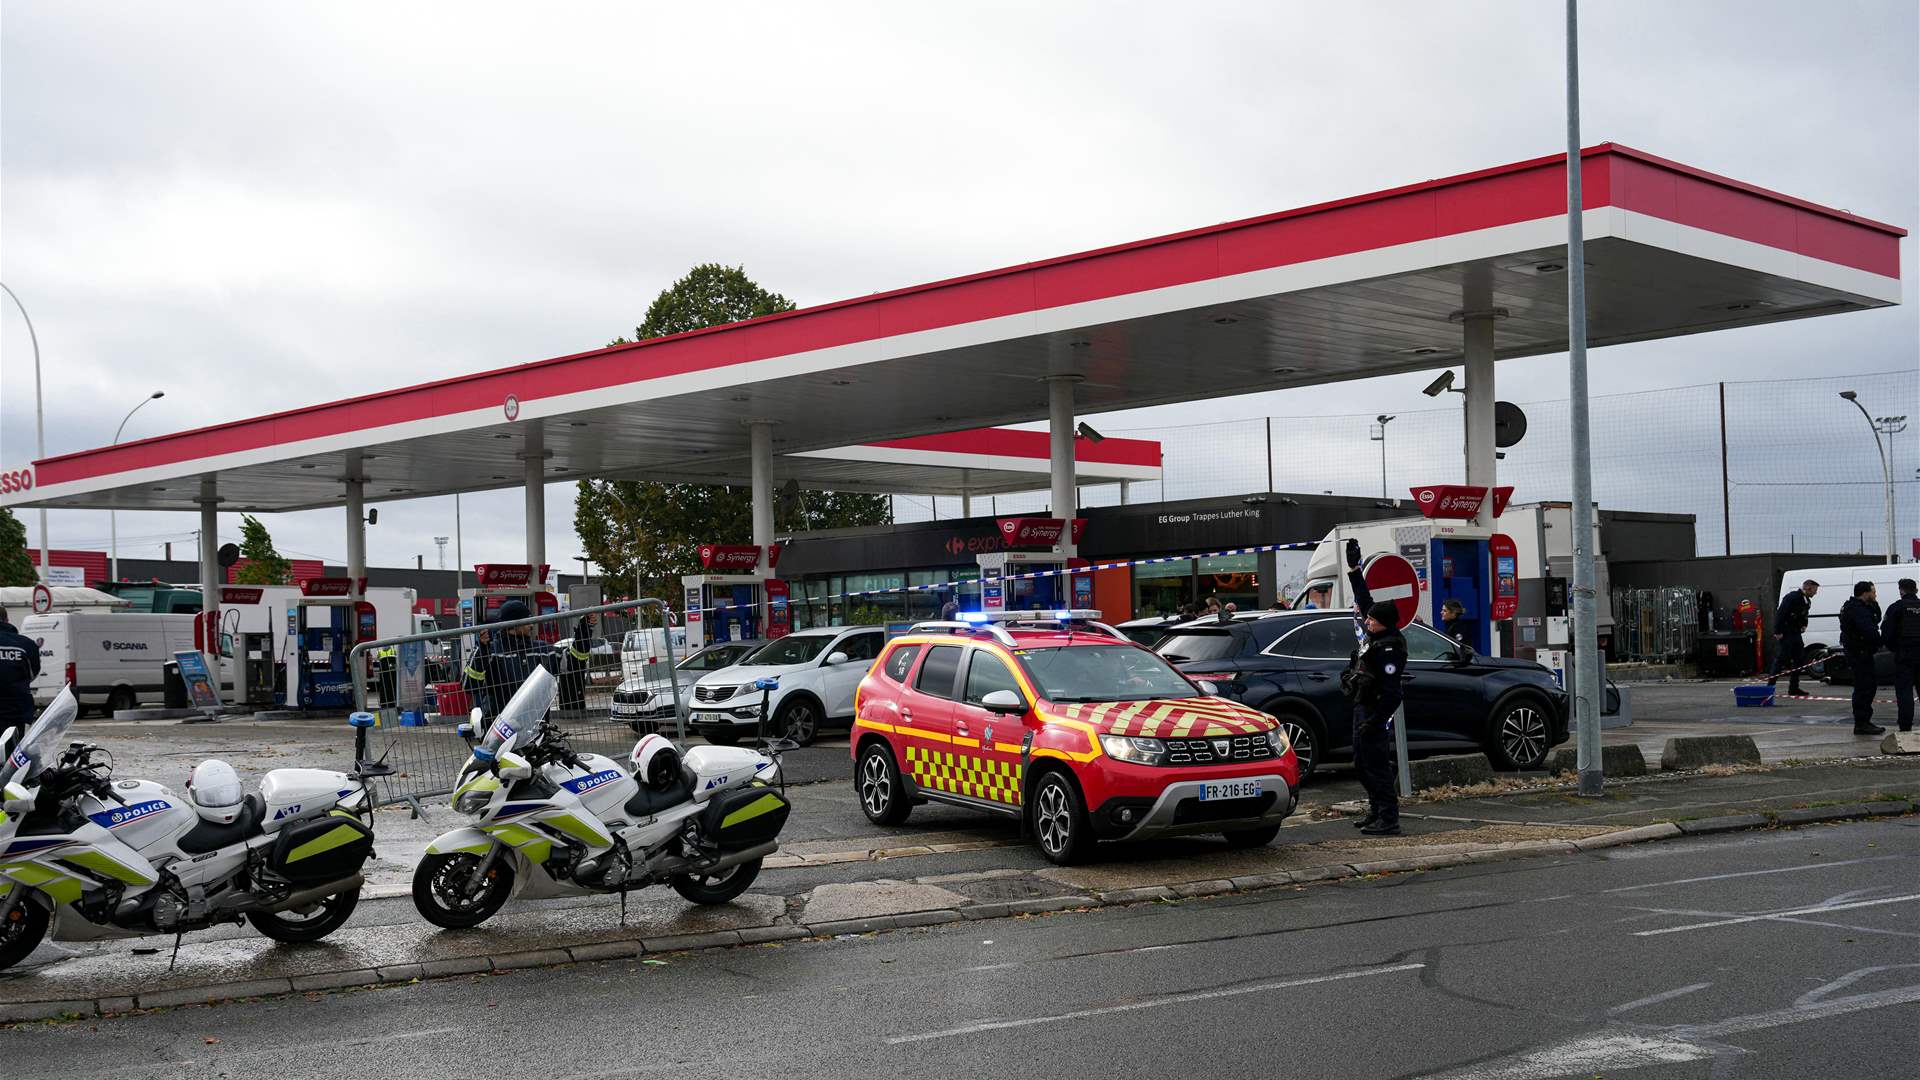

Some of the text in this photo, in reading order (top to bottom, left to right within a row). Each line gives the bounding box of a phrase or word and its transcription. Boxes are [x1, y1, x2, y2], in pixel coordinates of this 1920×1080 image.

[0, 469, 32, 494] SSO
[1451, 498, 1480, 512] Synergy
[1495, 494, 1500, 504] 1
[1158, 508, 1260, 524] EG Group Trappes Luther King
[1031, 527, 1058, 540] Synergy
[1073, 525, 1078, 534] 3
[726, 553, 757, 564] Synergy
[499, 571, 528, 580] Synergy
[113, 642, 148, 651] SCANIA
[0, 650, 22, 661] LICE
[314, 683, 353, 695] Syner
[586, 771, 619, 788] POLICE
[1206, 782, 1255, 799] FR-216-EG
[123, 801, 166, 820] POLICE
